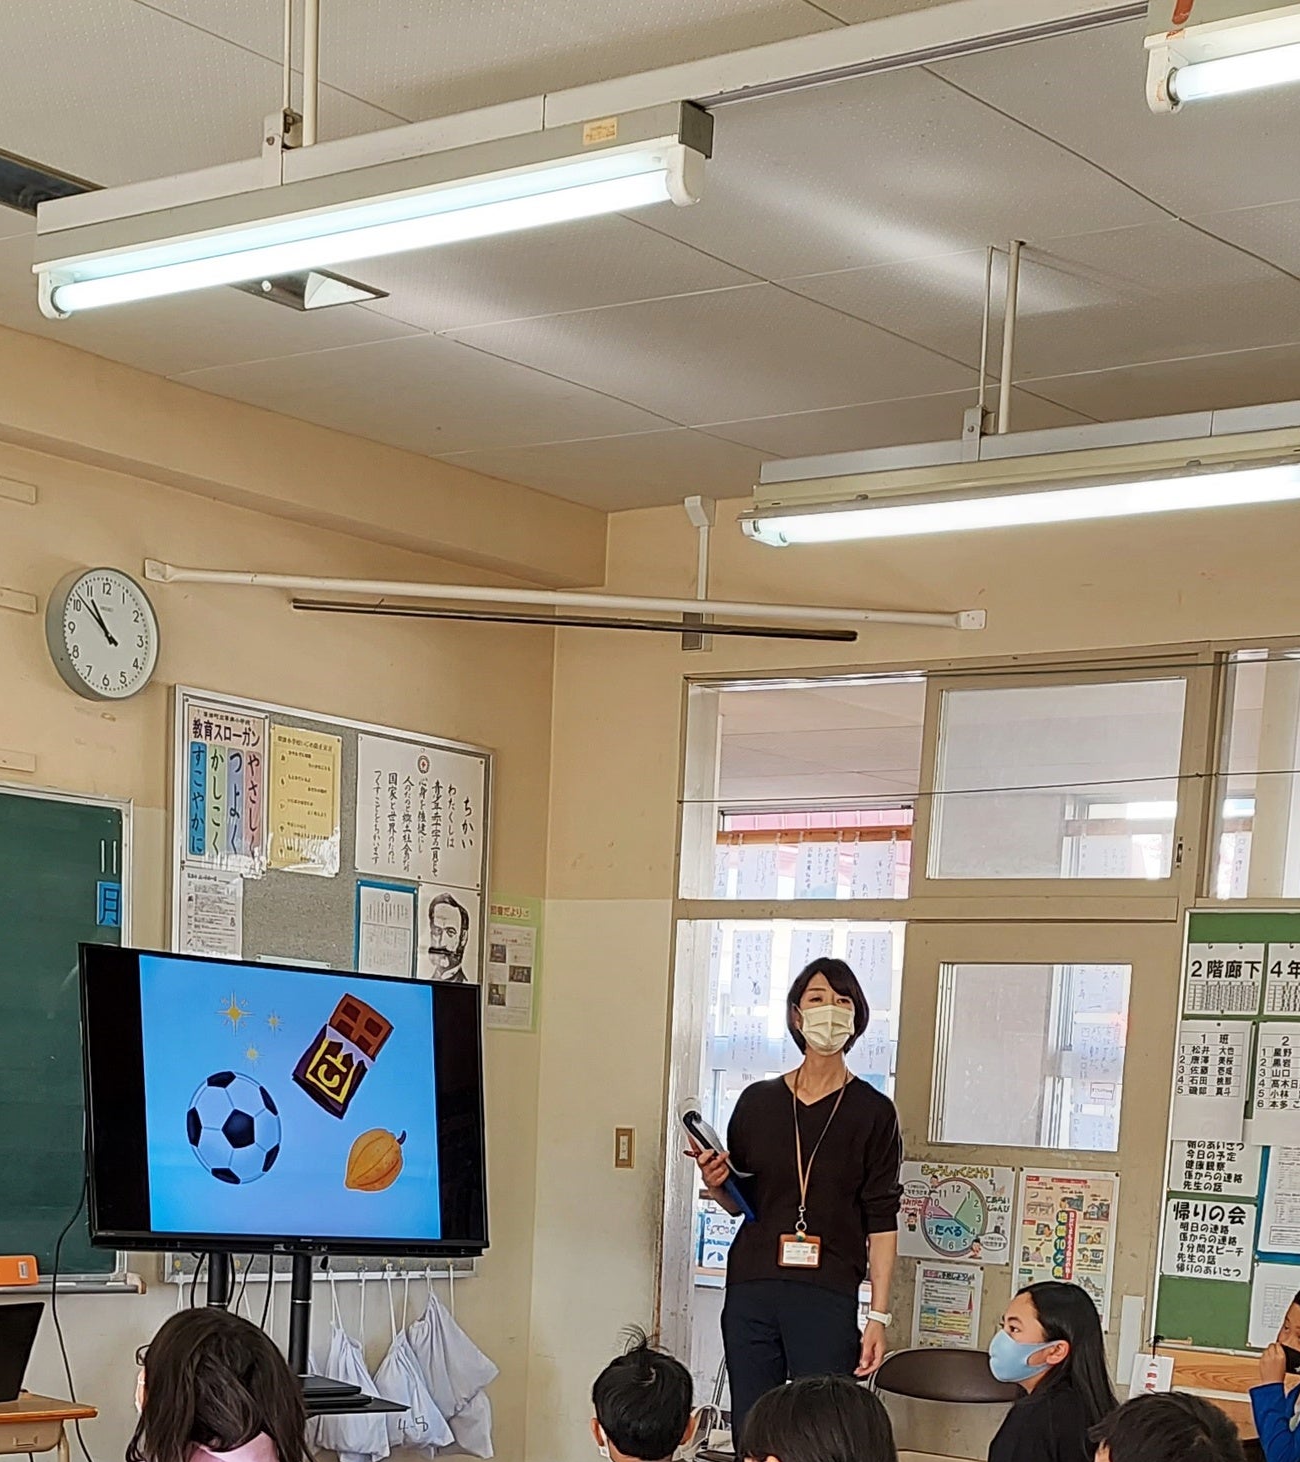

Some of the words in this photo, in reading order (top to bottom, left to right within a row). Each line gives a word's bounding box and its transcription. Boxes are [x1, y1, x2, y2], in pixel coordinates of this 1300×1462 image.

[87, 585, 92, 597] 11
[103, 583, 111, 595] 12
[122, 592, 125, 604] 1
[73, 599, 81, 612] 10
[133, 610, 139, 623] 2
[68, 622, 75, 634] 9
[137, 635, 143, 648] 3
[72, 645, 79, 659] 8
[133, 658, 138, 669] 4
[86, 666, 92, 676] 7
[103, 674, 109, 686] 6
[120, 672, 126, 684] 5
[193, 718, 260, 747] 教育スローガン
[192, 746, 204, 853] すこやかに
[211, 749, 224, 855] かしこく
[230, 753, 242, 854] つよく
[248, 755, 260, 862] やさしく
[447, 784, 456, 848] わたくしは
[462, 796, 474, 848] ちかい
[101, 839, 117, 875] 11
[100, 888, 119, 925] 月
[1191, 960, 1262, 978] 2階廊下
[1201, 1034, 1206, 1043] 1
[1220, 1034, 1229, 1044] 班
[1282, 1036, 1289, 1046] 2
[1187, 1150, 1236, 1162] 今日の予定
[1185, 1171, 1242, 1183] 係からの連絡
[952, 1185, 960, 1193] 12
[1183, 1182, 1222, 1192] 先生の話
[1173, 1202, 1246, 1224] 帰りの会
[935, 1225, 962, 1236] たべる
[1180, 1223, 1229, 1234] 明日の連絡
[1180, 1233, 1236, 1246] 係からの連絡
[1180, 1243, 1244, 1256] 1分間スピーチ
[1177, 1253, 1216, 1264] 先生の話
[1176, 1264, 1241, 1276] 帰りのあいさつ
